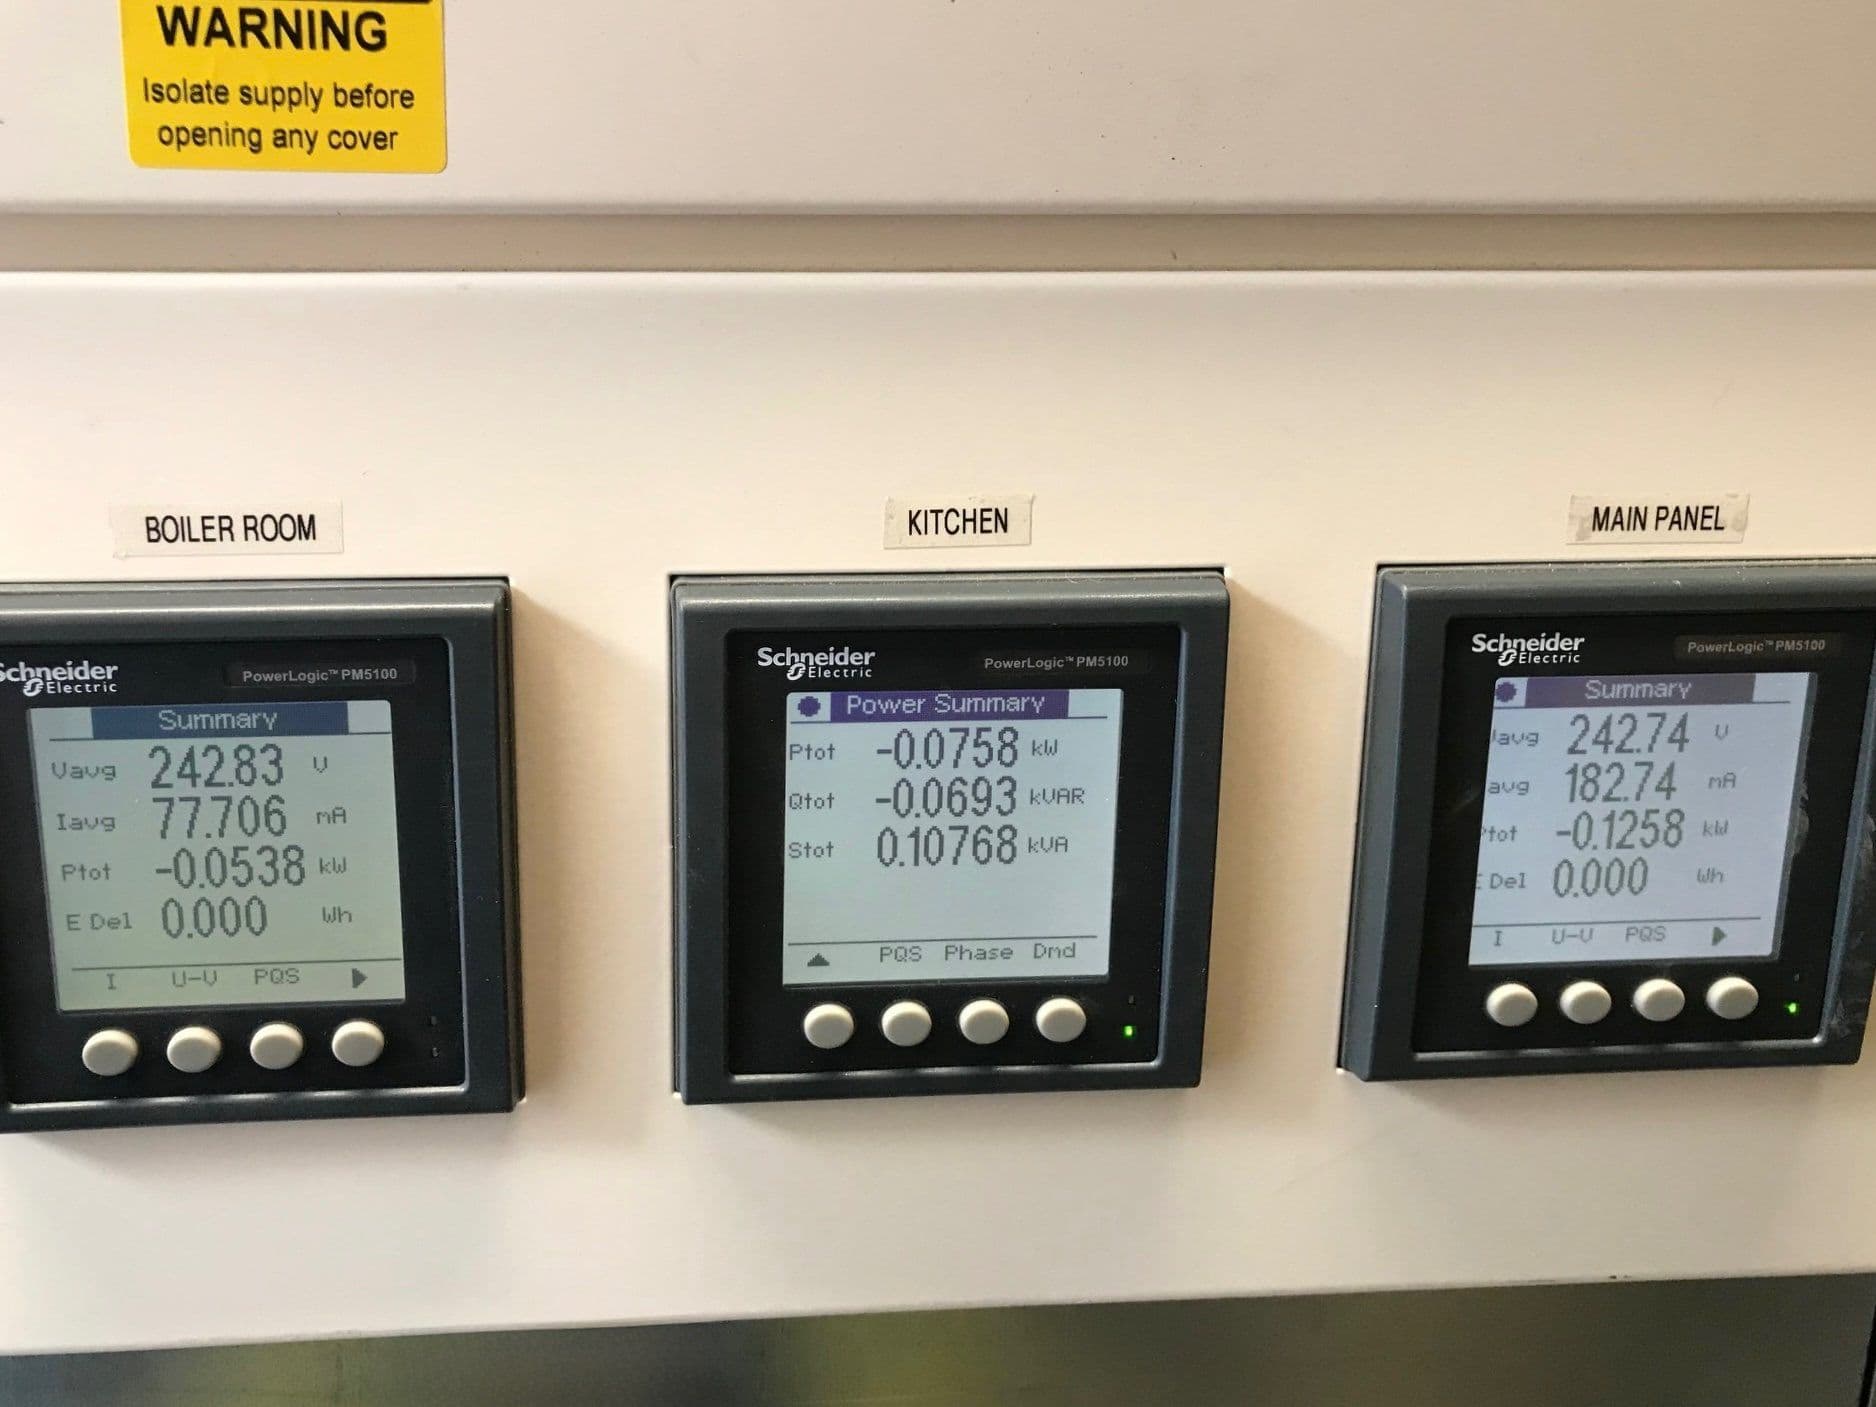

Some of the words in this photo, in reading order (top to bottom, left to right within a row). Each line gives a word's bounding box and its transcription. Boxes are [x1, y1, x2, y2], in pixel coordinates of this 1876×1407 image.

[157, 6, 387, 52] WARNING
[143, 77, 229, 104] Isolate
[240, 82, 323, 112] supply
[334, 82, 414, 109] before
[158, 122, 262, 154] opening
[272, 128, 318, 155] any
[328, 129, 398, 150] cover
[145, 515, 234, 543] BOILER
[243, 514, 316, 541] ROOM
[908, 508, 1008, 535] KITCHEN
[1592, 506, 1648, 531] MAIN
[1655, 505, 1725, 531] PANEL
[1471, 632, 1585, 652] Schneider
[1775, 639, 1826, 651] PM5100
[757, 647, 875, 666] Schneider
[1077, 656, 1129, 667] PM5100
[1519, 652, 1580, 664] Electric
[342, 668, 398, 681] PM5100
[808, 665, 873, 678] Electric
[48, 681, 117, 693] Electric
[1585, 680, 1692, 700] Summary
[847, 696, 926, 715] Power
[934, 694, 1045, 713] Summary
[159, 710, 278, 731] Summary
[1567, 712, 1689, 755] 242.74
[789, 744, 835, 761] Ptot
[876, 727, 1019, 769] -0.0758
[1032, 740, 1058, 756] kW
[52, 761, 116, 780] Vavg
[149, 744, 283, 789] 242.83
[1487, 781, 1529, 795] avg
[1565, 761, 1676, 803] 182.74
[1708, 772, 1737, 789] mA
[788, 793, 834, 810] Qtot
[875, 776, 1018, 818] -0.0693
[1029, 787, 1084, 804] kVAR
[56, 814, 116, 832] Iavg
[152, 795, 286, 839] 77.706
[316, 808, 347, 824] mA
[1481, 825, 1518, 842] tot
[1556, 808, 1685, 850] -0.1258
[788, 843, 834, 859] Stot
[876, 824, 1018, 866] 0.10768
[1027, 837, 1068, 853] kVA
[62, 864, 111, 880] Ptot
[156, 845, 305, 889] -0.0538
[320, 857, 346, 874] kW
[1490, 873, 1526, 890] Del
[1553, 856, 1648, 898] 0.000
[1697, 868, 1723, 884] Wh
[66, 915, 81, 931] E
[91, 913, 133, 930] Del
[161, 896, 267, 939] 0.000
[322, 907, 352, 923] Wh
[1625, 926, 1666, 941] PQS
[879, 946, 922, 962] PQS
[944, 944, 1013, 961] Phase
[1033, 943, 1075, 959] Dnd
[255, 969, 300, 984] PQS
